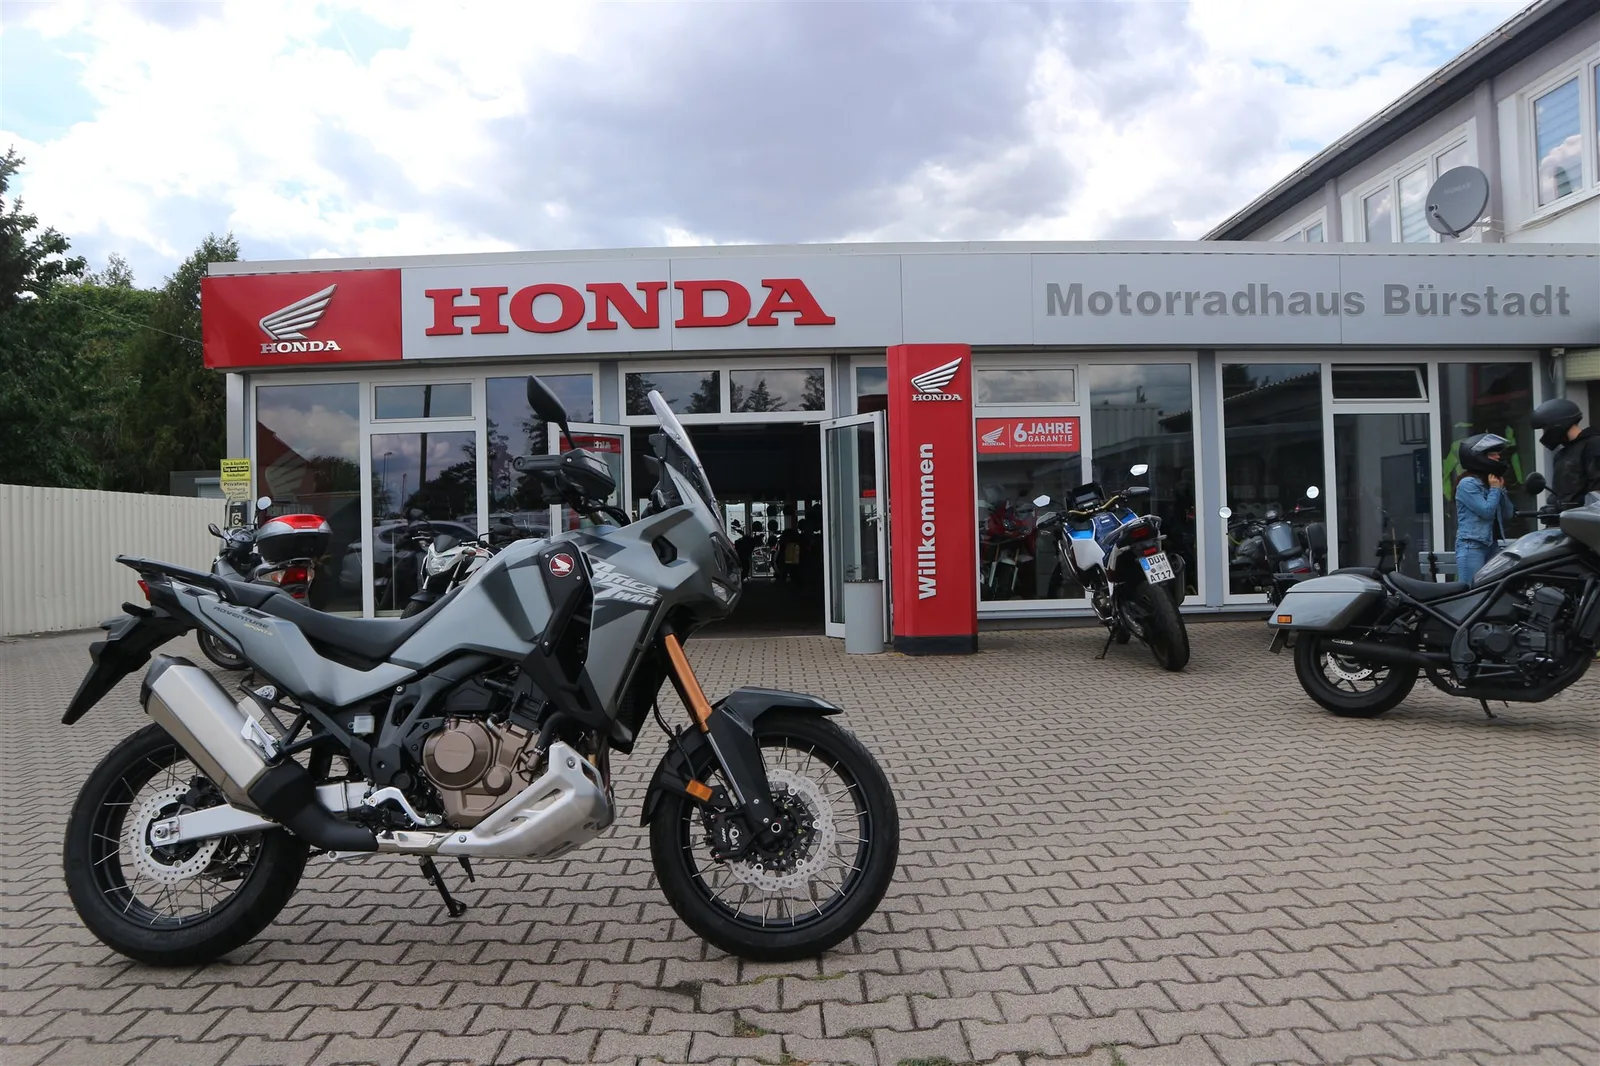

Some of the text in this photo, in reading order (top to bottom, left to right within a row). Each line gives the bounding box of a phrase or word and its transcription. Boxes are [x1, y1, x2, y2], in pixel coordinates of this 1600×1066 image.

[425, 279, 835, 336] HONDA
[1046, 282, 1571, 317] Motorradhaus Bürstadt
[260, 340, 341, 354] HONDA
[912, 393, 963, 402] HONDA
[1013, 422, 1073, 443] 6 JAHRE
[1028, 434, 1073, 442] GARANTIE
[917, 443, 937, 600] Willkommen
[1150, 569, 1171, 582] AT17
[213, 606, 269, 629] ADVENTURE
